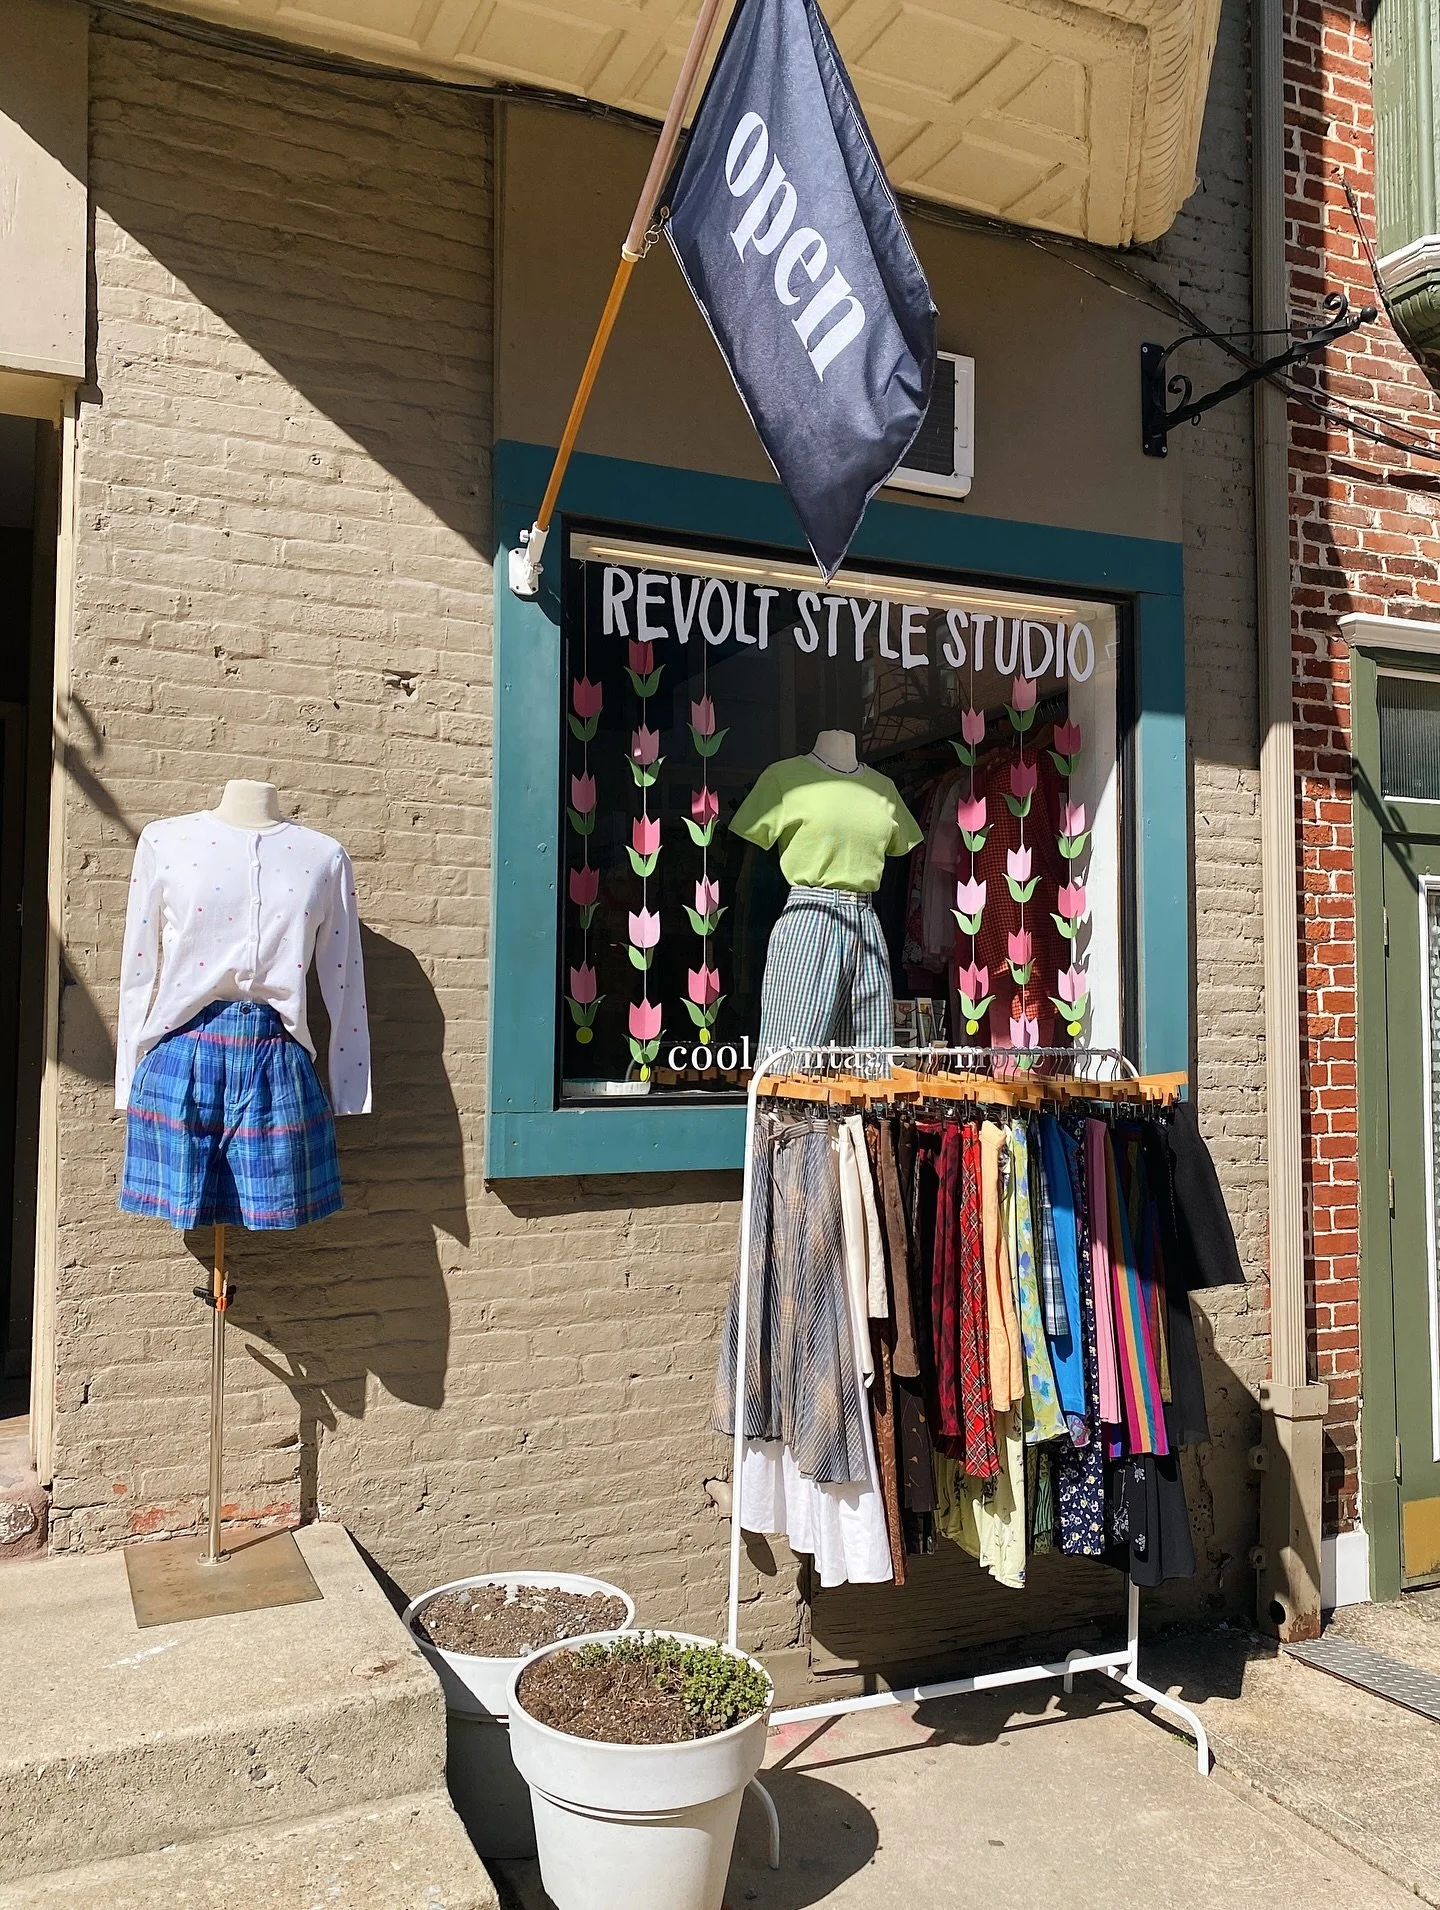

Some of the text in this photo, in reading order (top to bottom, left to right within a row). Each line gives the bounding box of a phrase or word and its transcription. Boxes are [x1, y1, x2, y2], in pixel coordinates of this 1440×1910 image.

[724, 111, 866, 383] open
[603, 567, 1095, 683] REVOLT STYLE STUDIO
[667, 1035, 752, 1071] cool
